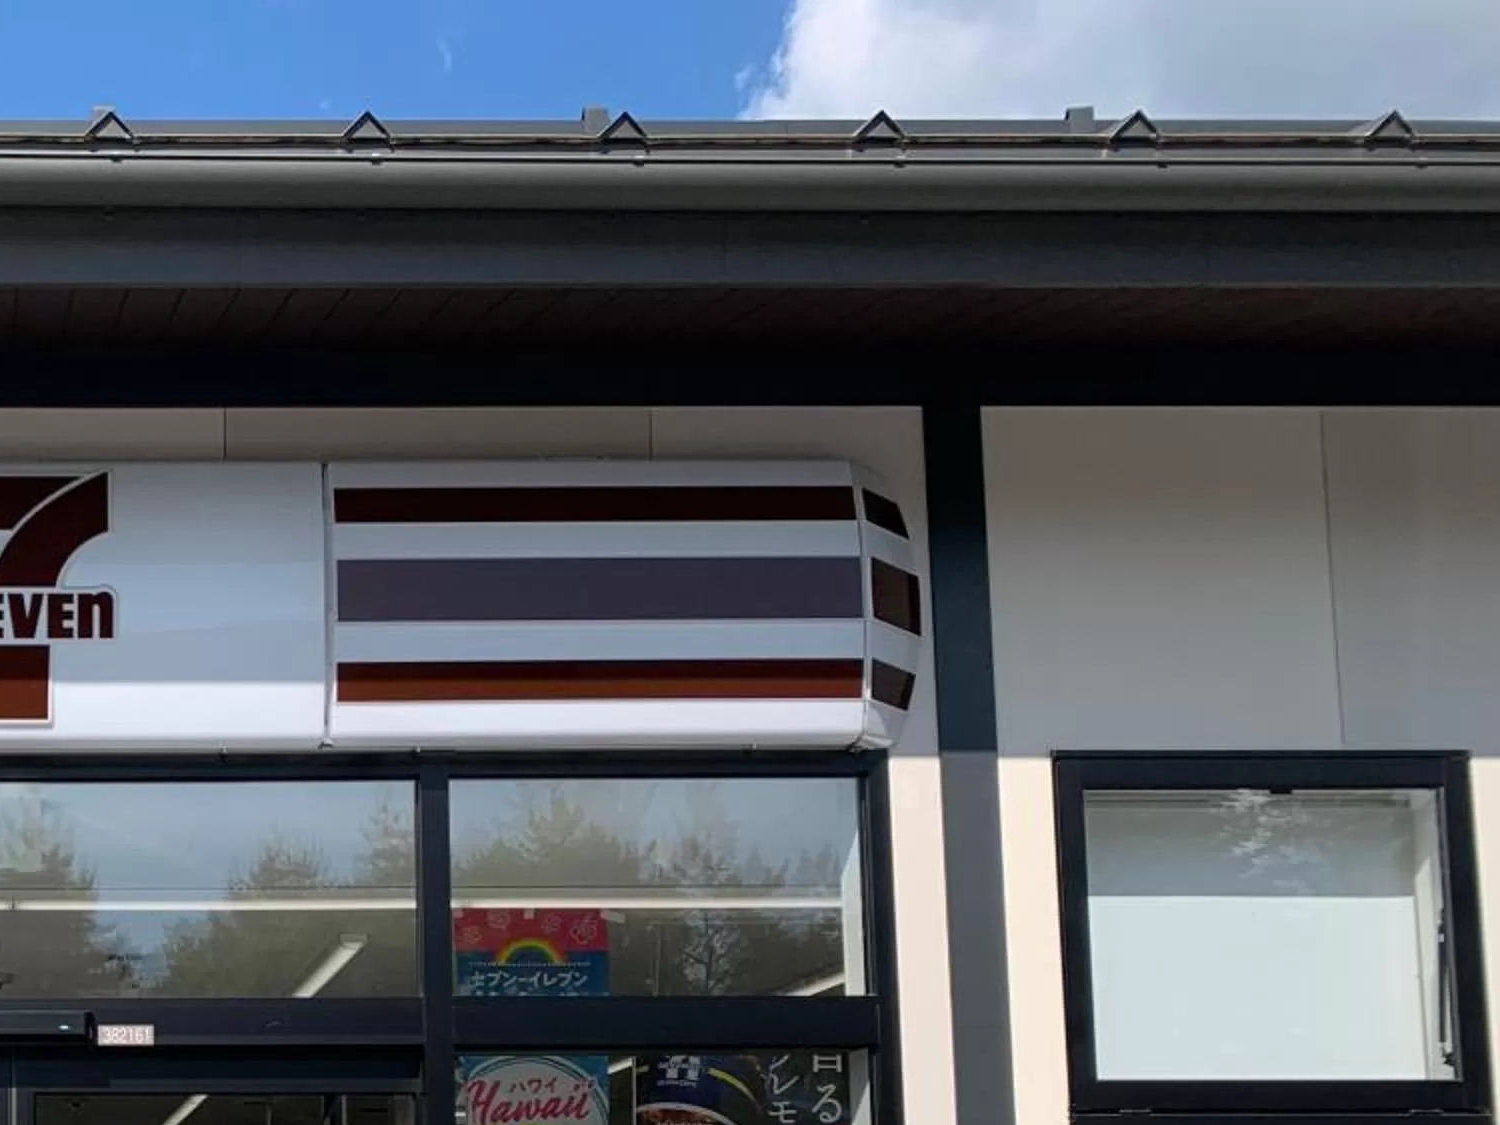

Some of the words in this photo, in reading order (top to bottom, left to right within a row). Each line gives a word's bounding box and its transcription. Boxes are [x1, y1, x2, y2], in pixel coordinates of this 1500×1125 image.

[102, 1027, 150, 1044] 382161
[509, 1076, 558, 1093] ハワイ
